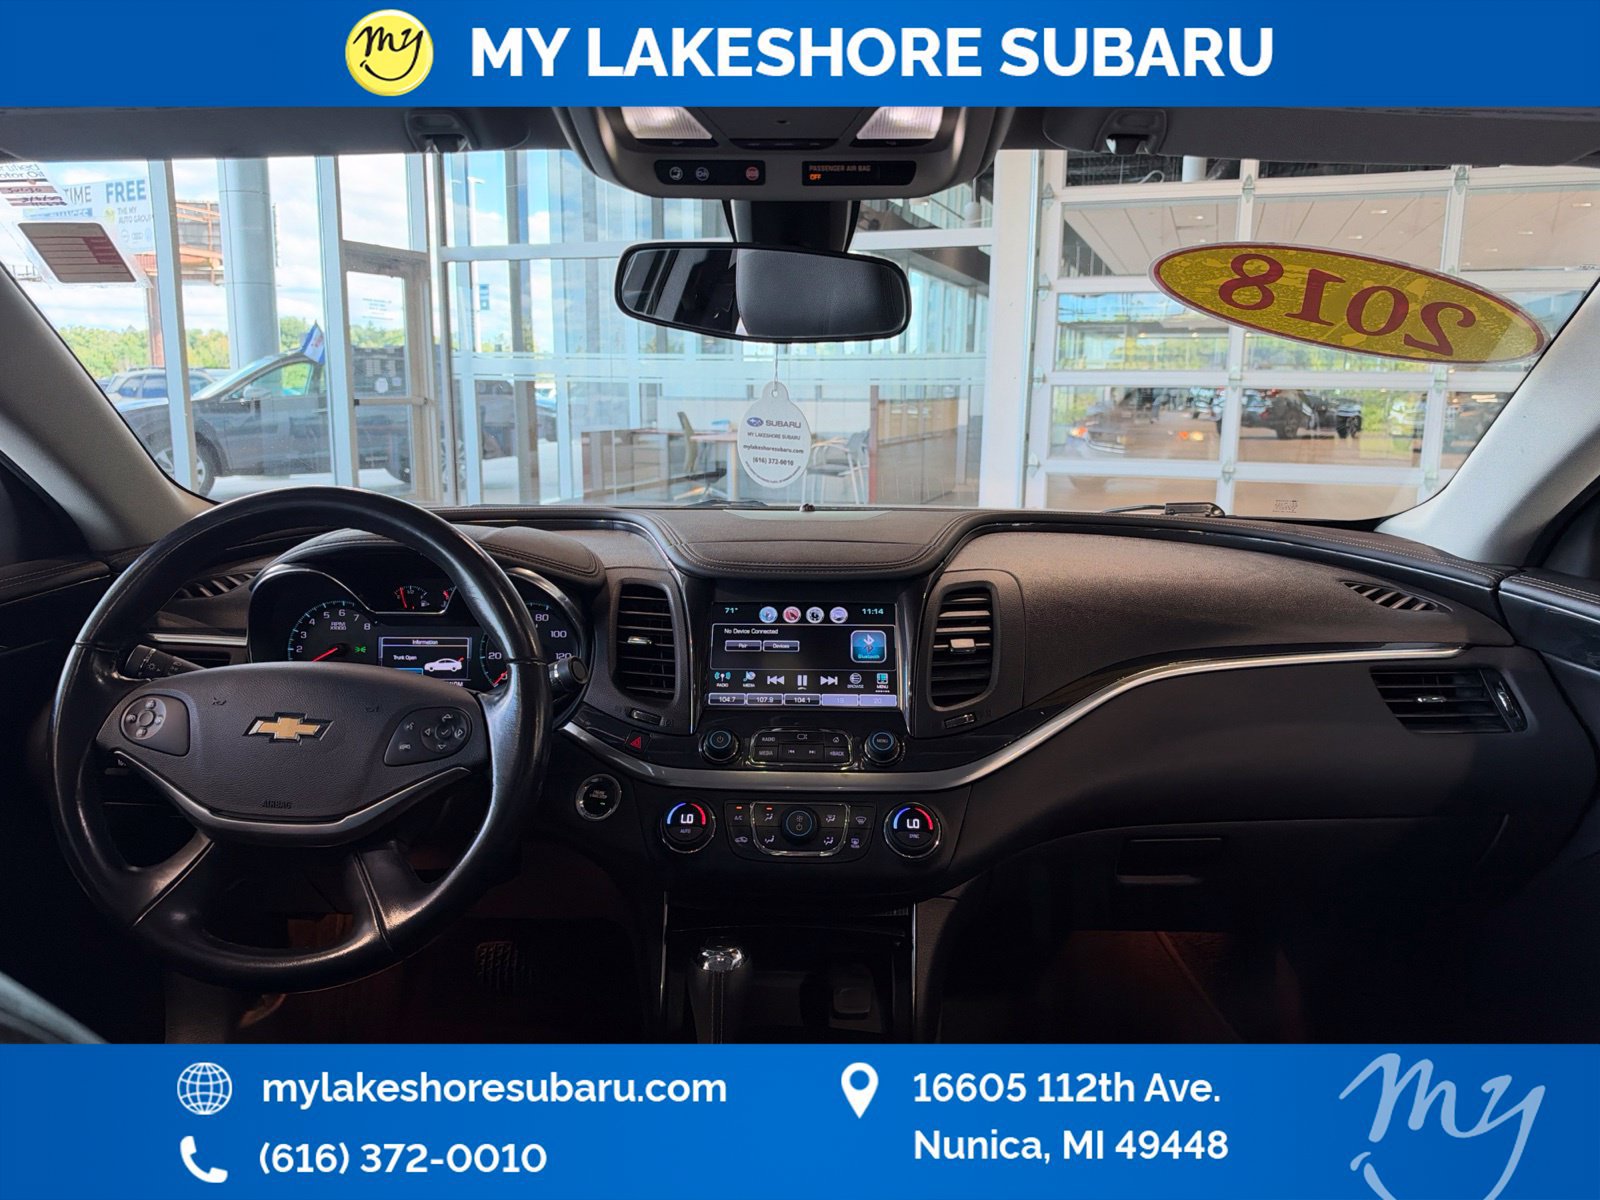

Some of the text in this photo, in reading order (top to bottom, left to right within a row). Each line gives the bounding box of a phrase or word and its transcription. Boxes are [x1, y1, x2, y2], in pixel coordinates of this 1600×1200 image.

[105, 180, 147, 203] FREE
[765, 420, 801, 428] SUBARU
[743, 444, 804, 454] mylakeshoresubaru.com
[768, 458, 794, 466] 372-0010
[323, 611, 330, 619] 5
[339, 609, 346, 617] 6
[535, 613, 550, 621] 80
[308, 618, 316, 626] 4
[363, 622, 371, 630] 8
[300, 631, 307, 639] 3
[550, 630, 567, 638] 100
[296, 645, 303, 653] 2
[488, 651, 502, 660] 20
[262, 800, 292, 809] AIRBAG
[680, 813, 694, 824] LO
[906, 818, 920, 829] LO
